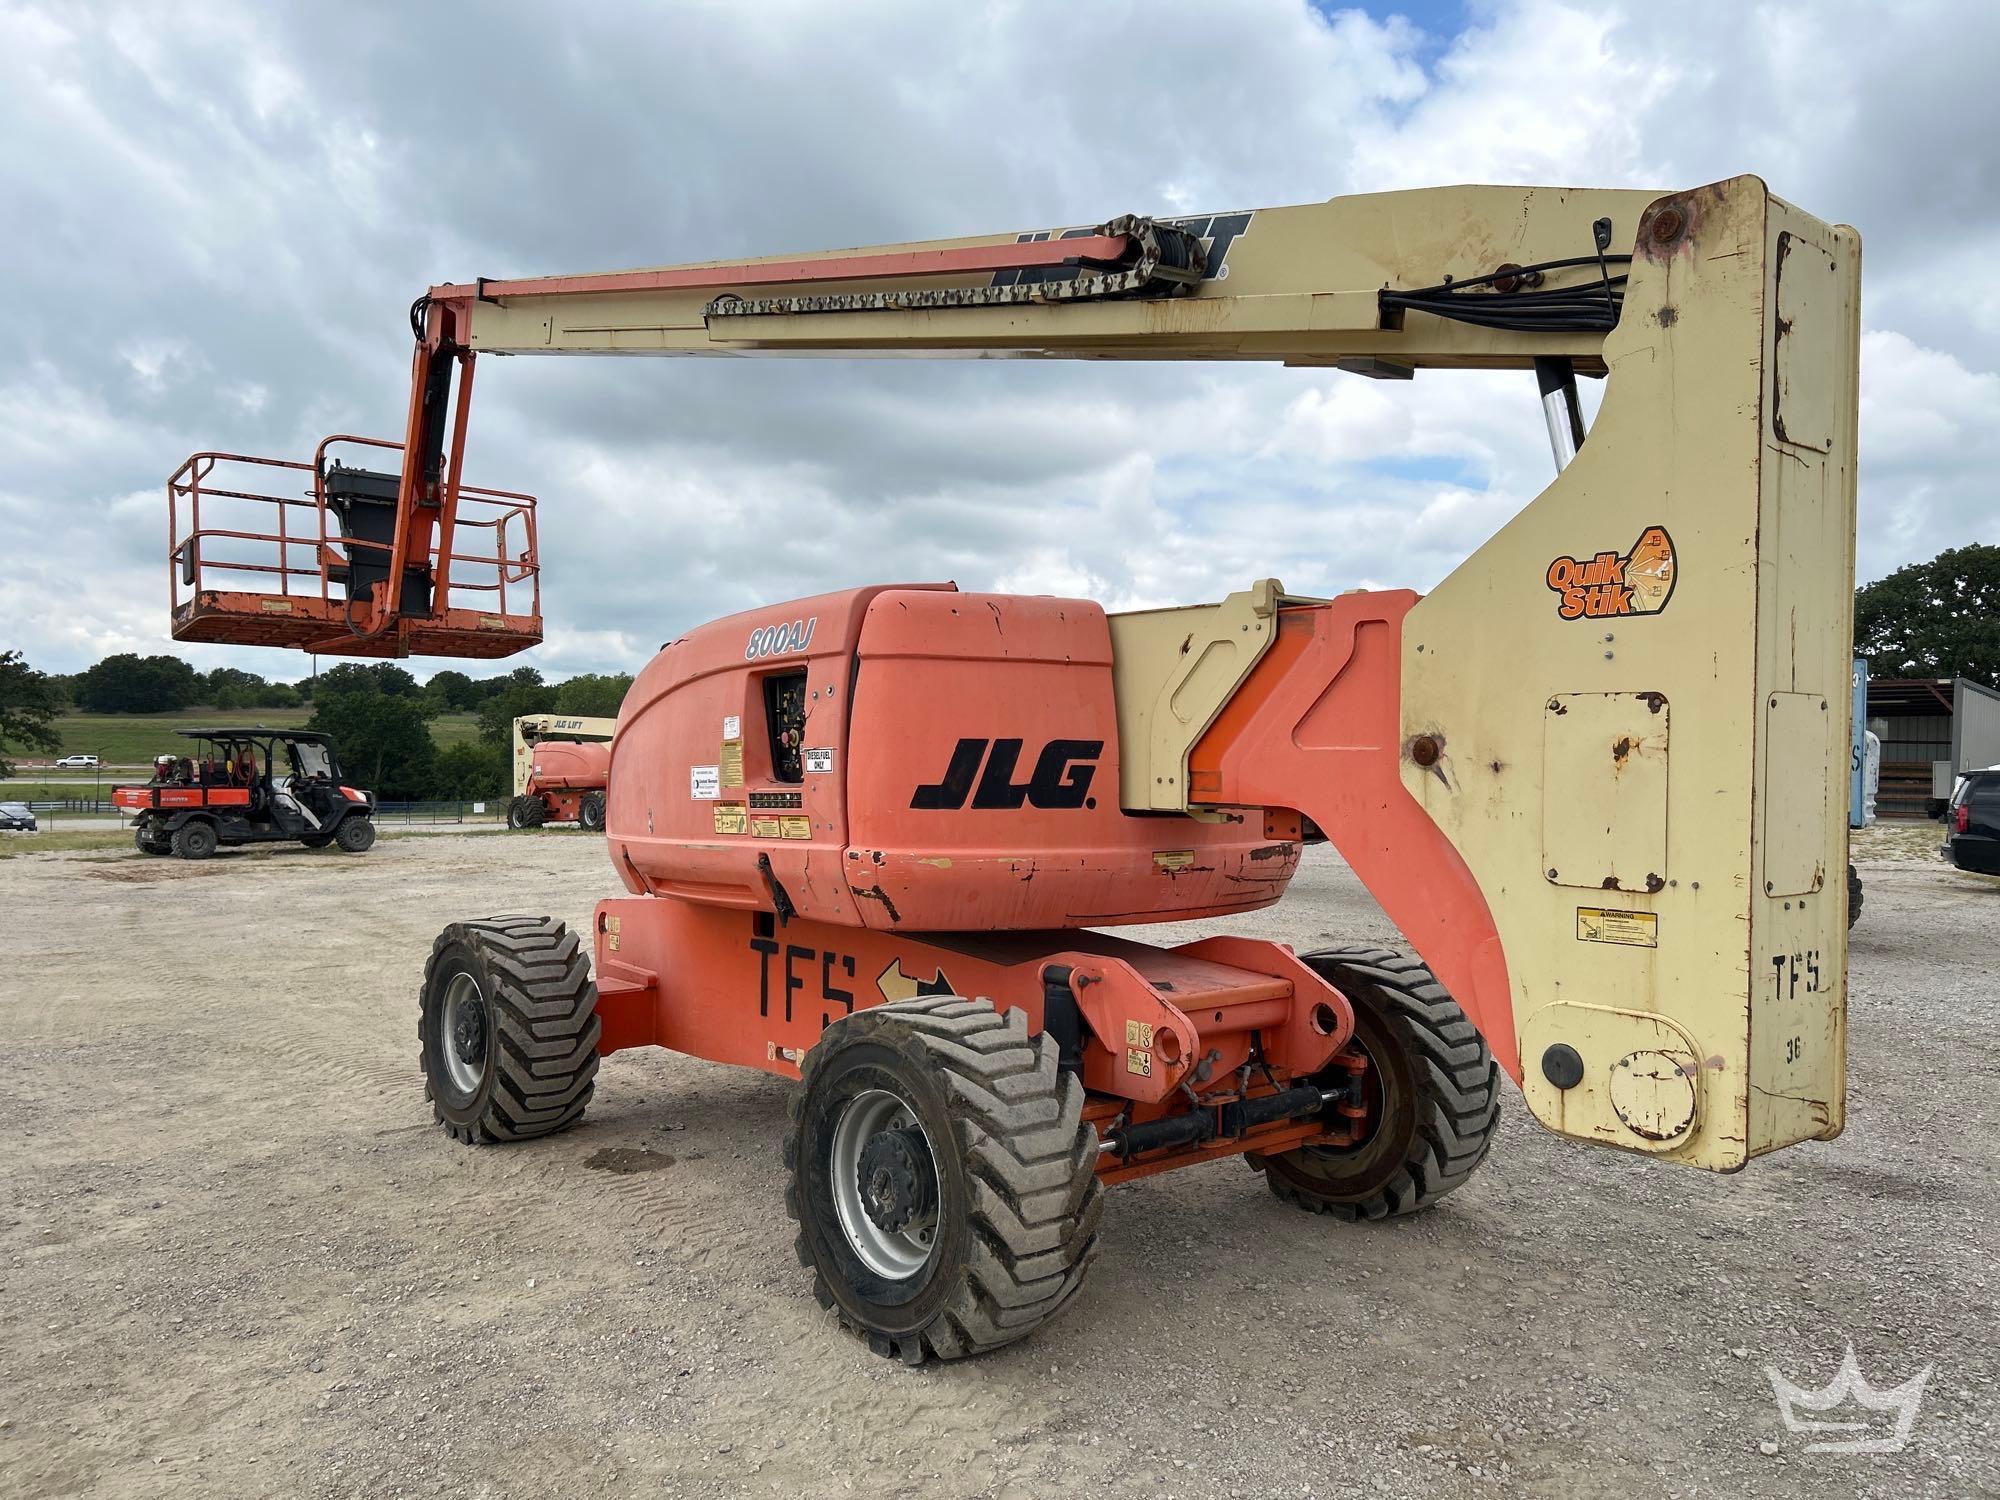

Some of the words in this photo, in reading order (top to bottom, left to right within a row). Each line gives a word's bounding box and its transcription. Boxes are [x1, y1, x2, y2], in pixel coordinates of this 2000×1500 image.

[1548, 554, 1628, 593] Quik
[1560, 585, 1634, 618] Stik
[745, 617, 817, 661] 800AJ
[554, 720, 567, 729] JLG
[568, 720, 583, 730] LIFT
[807, 751, 820, 760] DIESEL
[820, 751, 831, 760] FUEL
[813, 760, 825, 770] ONLY
[1605, 912, 1635, 920] WARNING
[750, 938, 855, 1031] TFS
[1772, 950, 1819, 1000] TFS
[1786, 1035, 1801, 1064] 36
